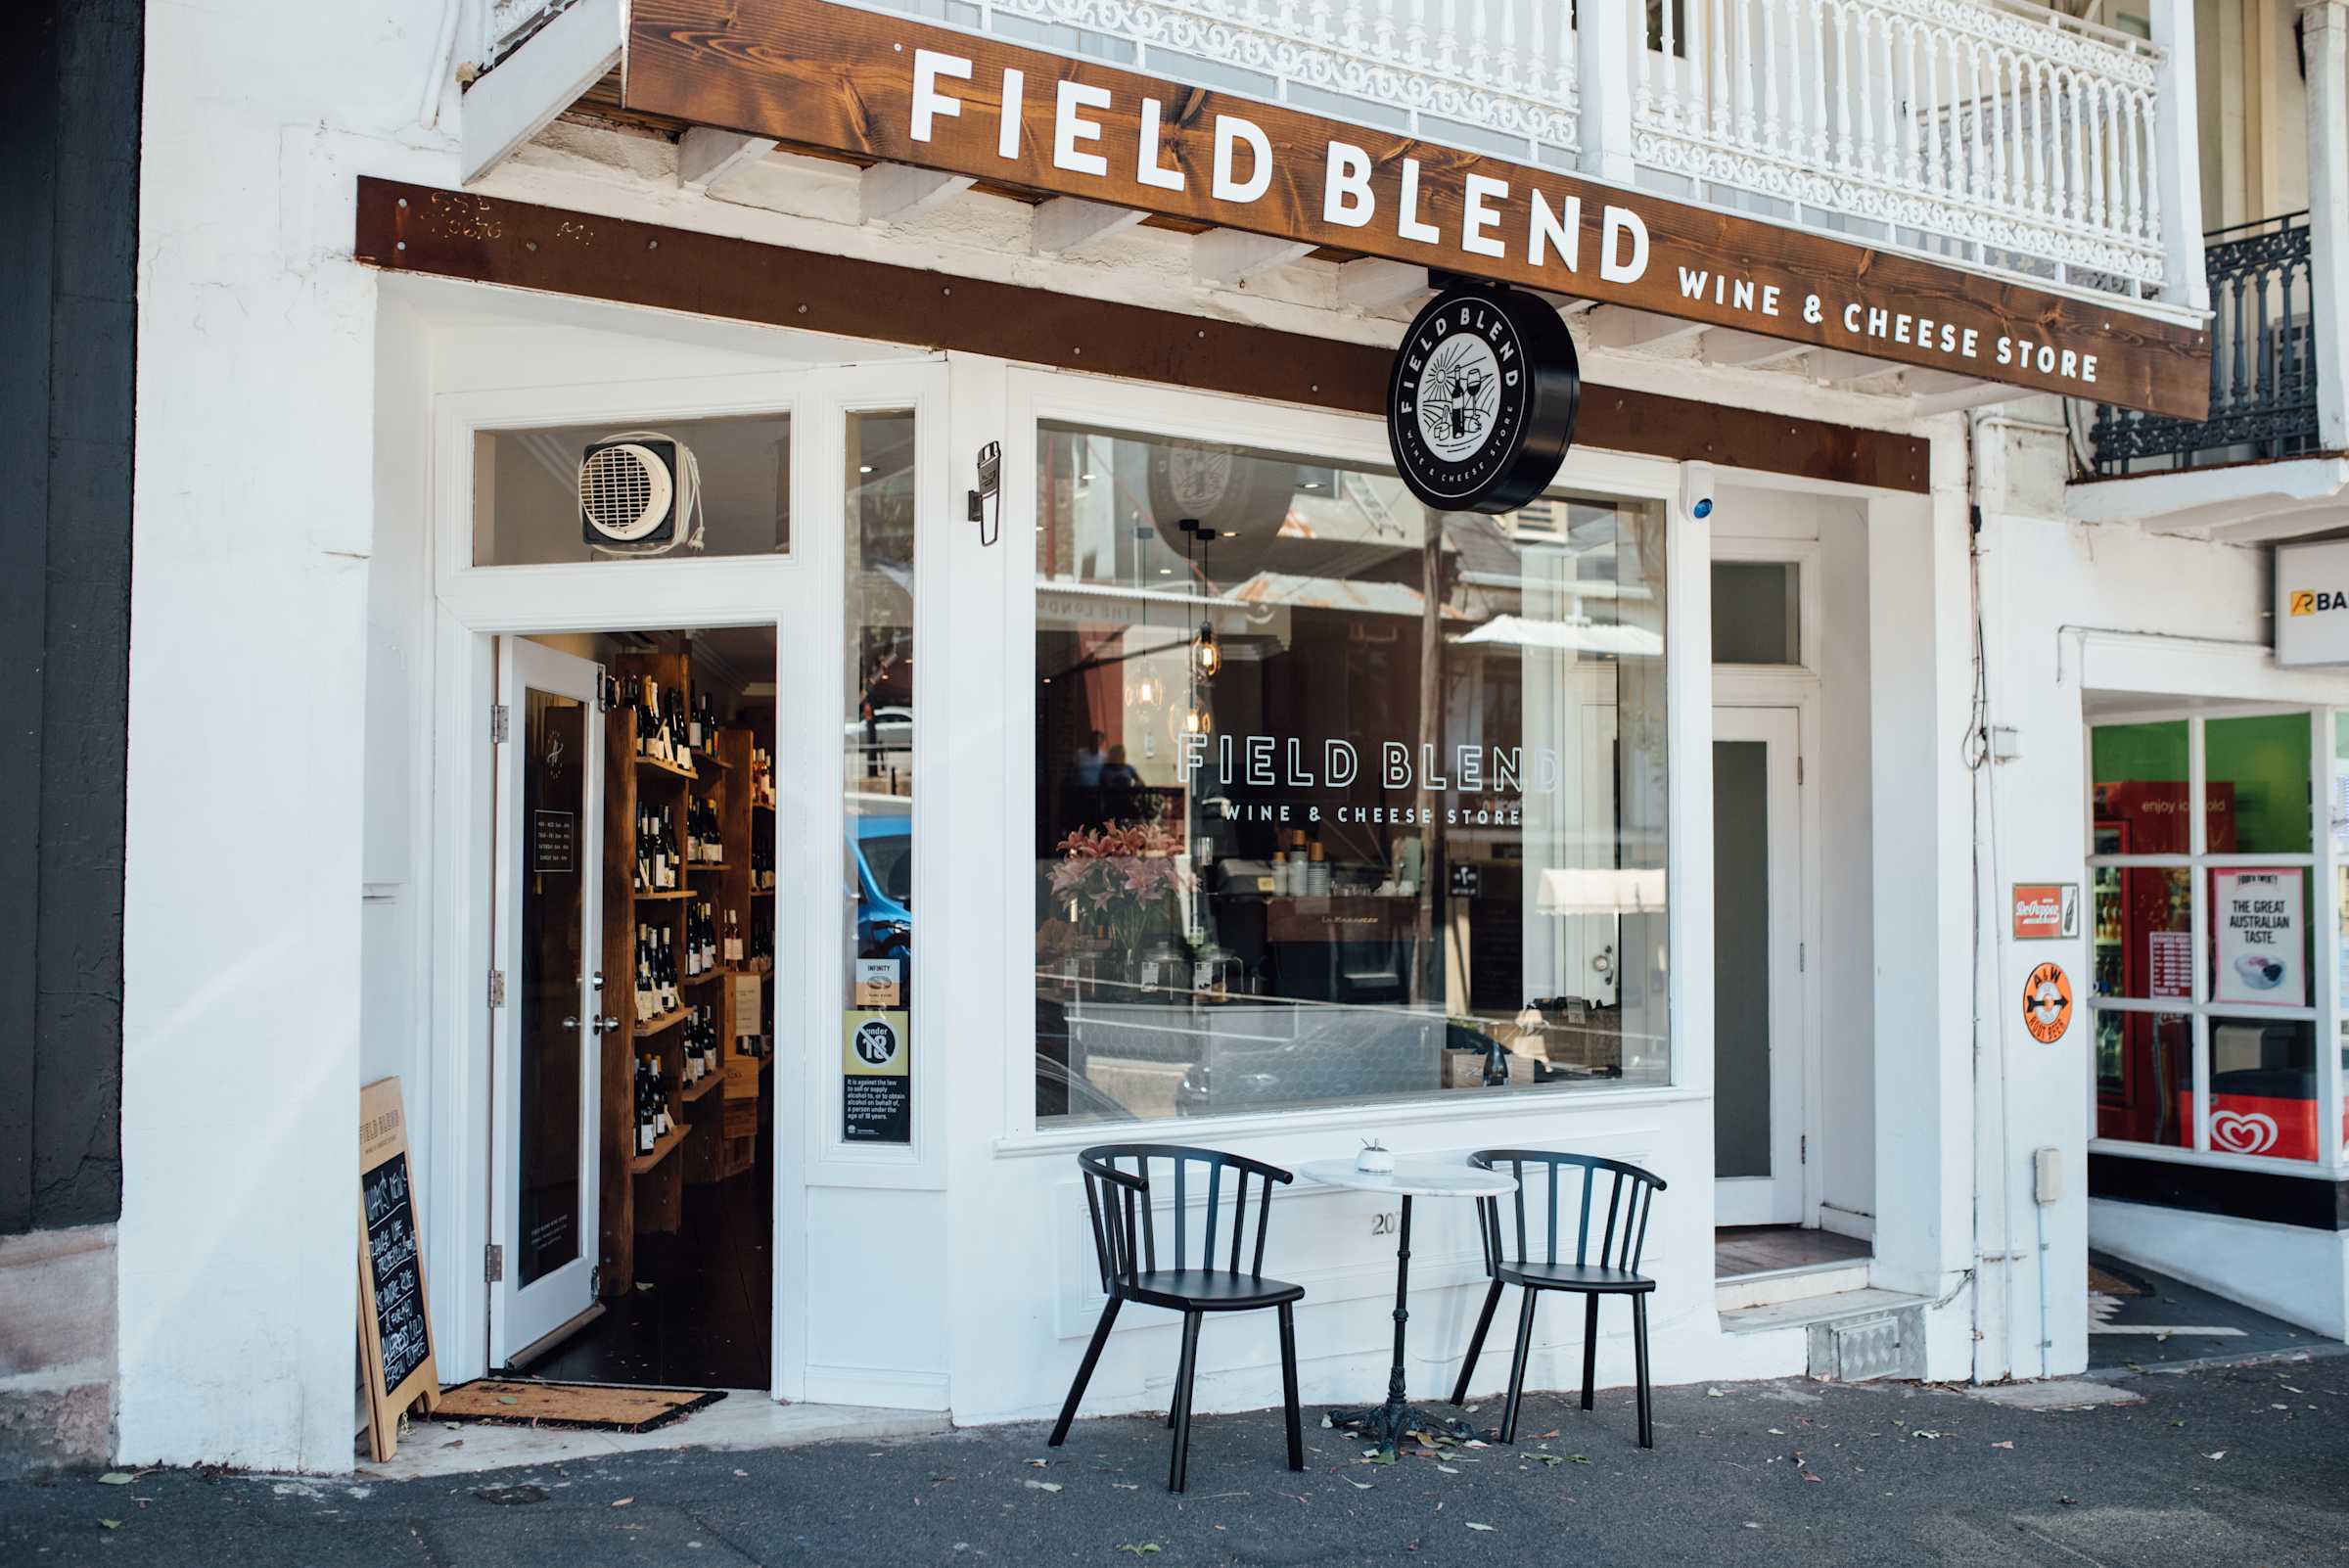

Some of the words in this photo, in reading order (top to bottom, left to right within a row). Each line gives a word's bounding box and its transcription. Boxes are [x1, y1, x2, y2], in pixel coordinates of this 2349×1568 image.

[909, 47, 1274, 205] FIELD
[1322, 140, 1651, 286] BLEND
[1678, 265, 1780, 317] WINE
[1803, 294, 1824, 325] &
[1843, 302, 1979, 358] CHEESE
[1996, 336, 2097, 384] STORE
[1401, 317, 1448, 414] FIELD
[1460, 307, 1519, 388] BLEND
[1406, 429, 1425, 467] WINE
[1441, 461, 1485, 484] CHEESE
[1490, 405, 1514, 457] STORE
[2317, 591, 2349, 612] BA
[1176, 732, 1359, 789] FIELD
[1382, 741, 1559, 793] BLEND
[1224, 805, 1291, 823] WINE
[1309, 806, 1321, 823] &
[1337, 806, 1432, 825] CHEESE
[1448, 808, 1520, 826] STORE
[2141, 799, 2176, 814] enjoy
[2206, 799, 2226, 811] old
[2232, 900, 2250, 913] THE
[2254, 900, 2286, 913] GREAT
[2230, 916, 2289, 929] AUSTRALIAN
[866, 1027, 888, 1036] under
[862, 1035, 888, 1059] 18
[1371, 1213, 1395, 1236] 20
